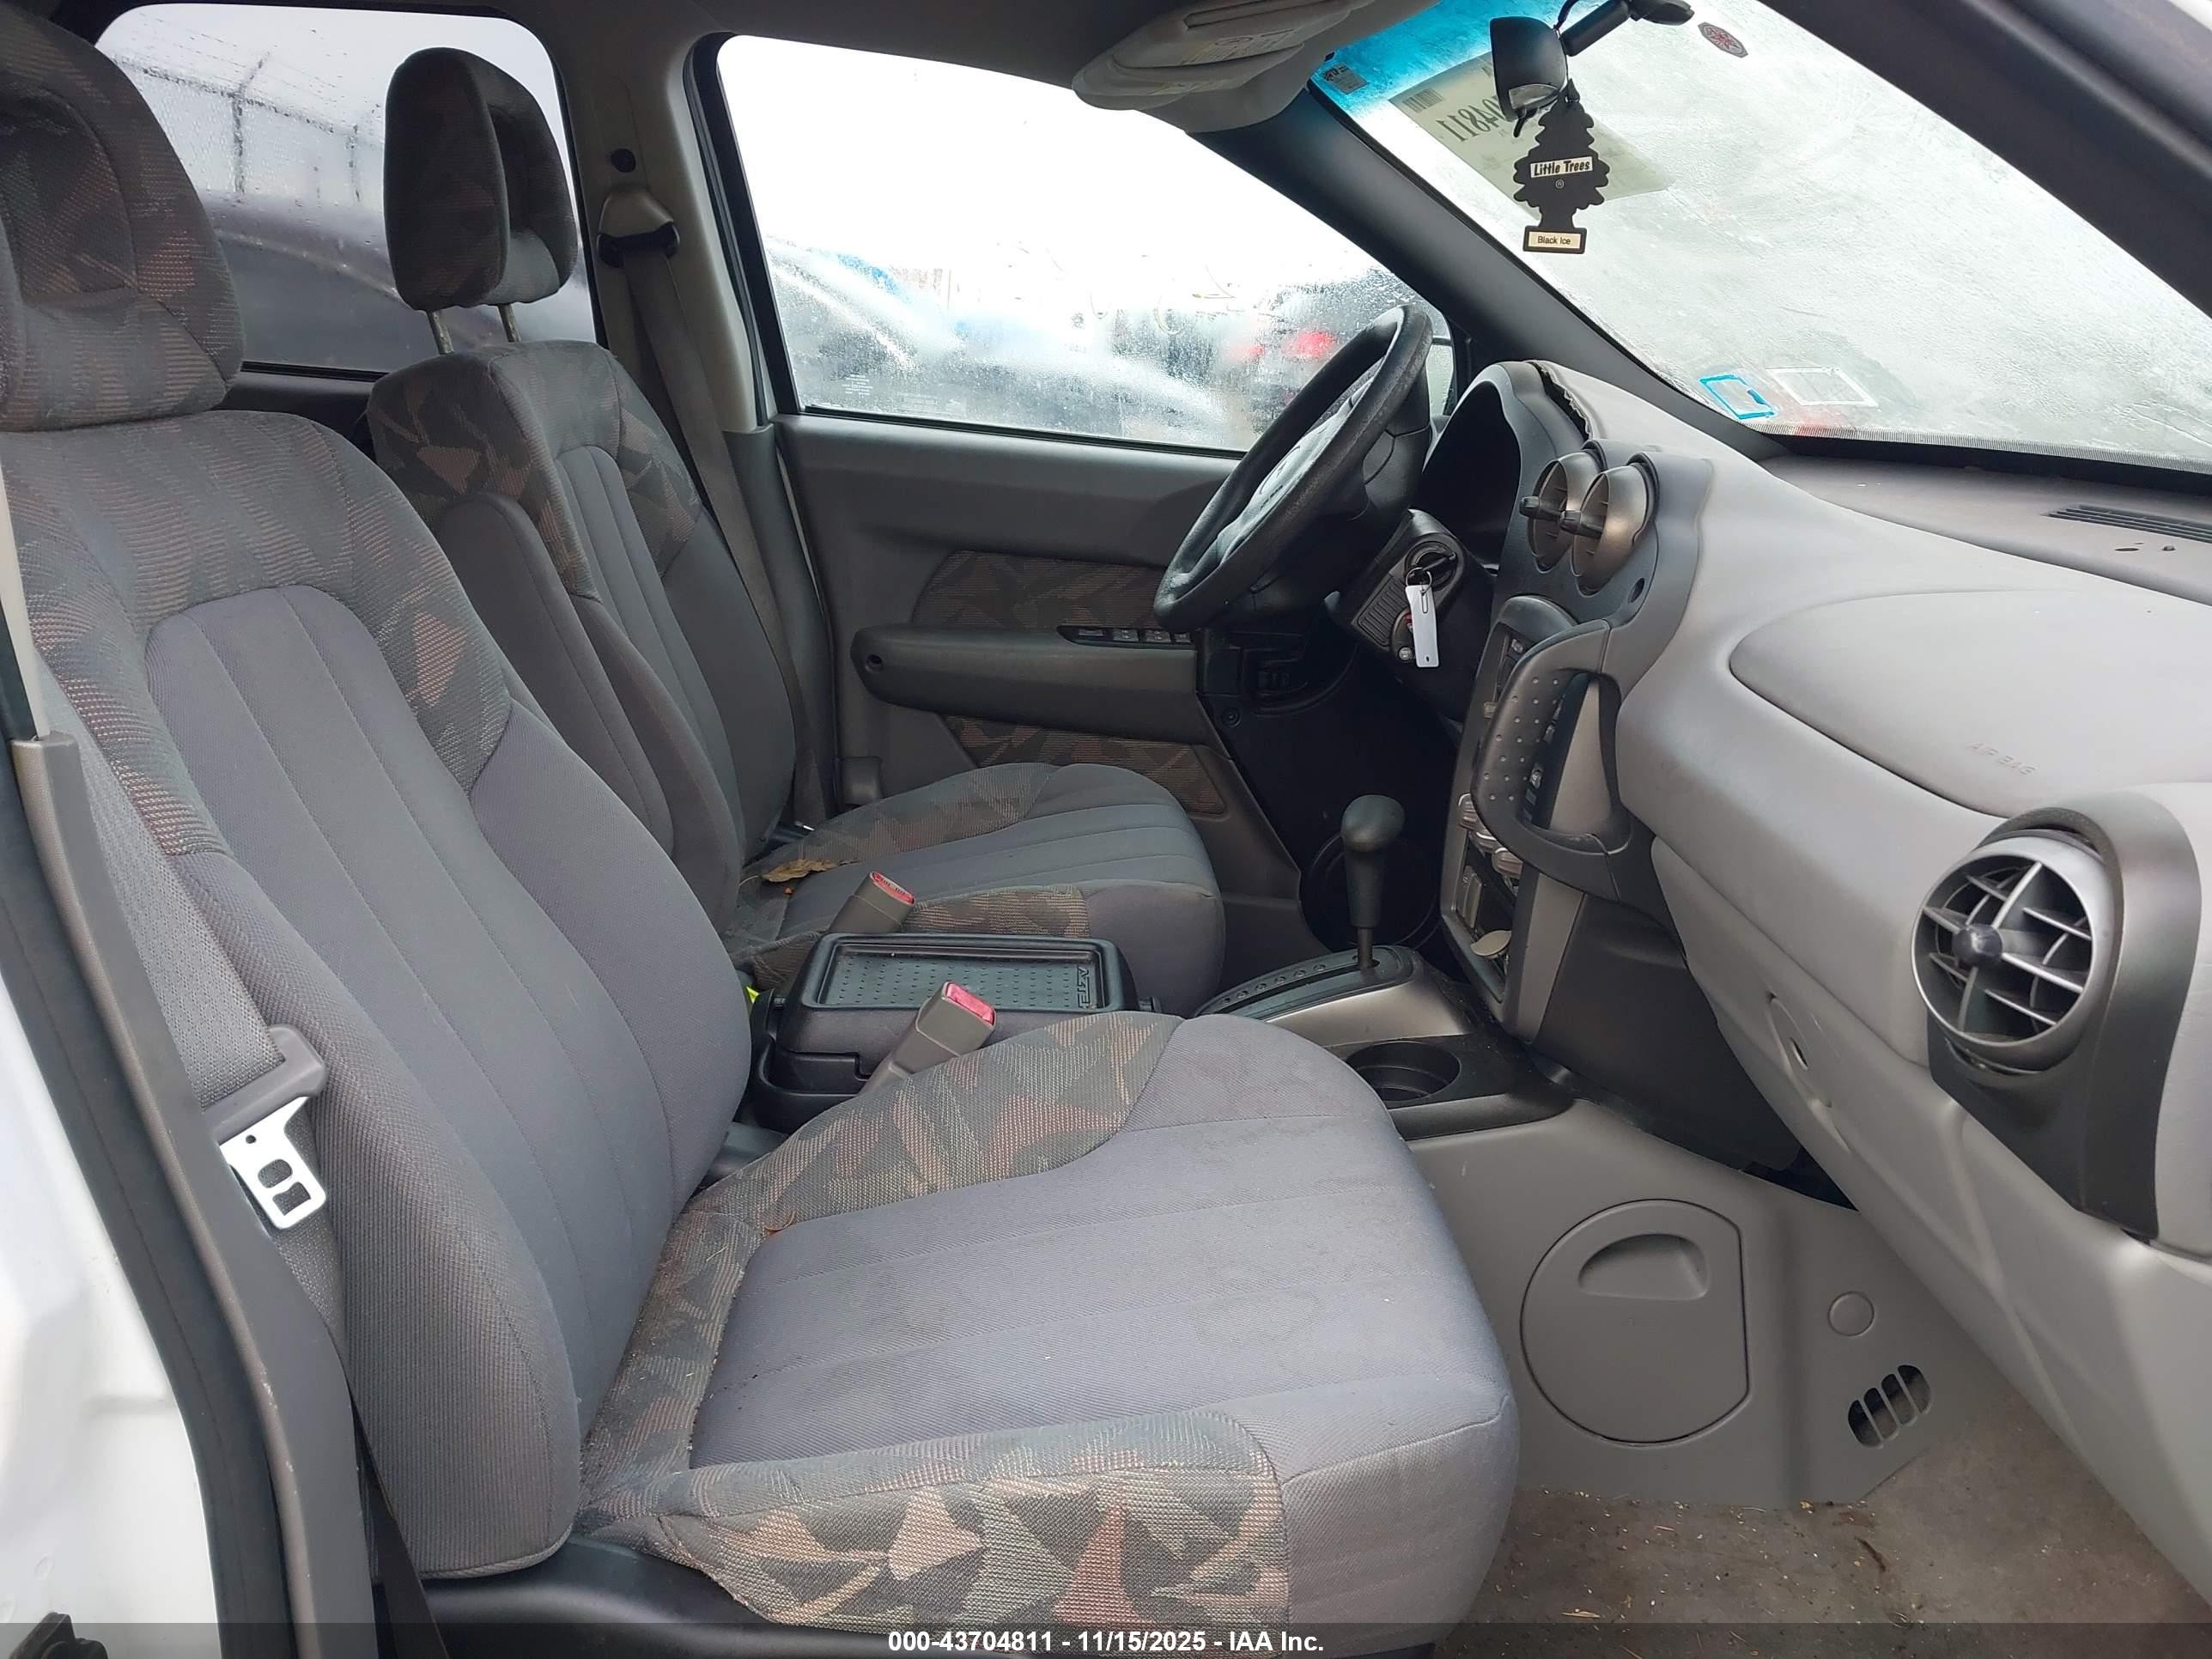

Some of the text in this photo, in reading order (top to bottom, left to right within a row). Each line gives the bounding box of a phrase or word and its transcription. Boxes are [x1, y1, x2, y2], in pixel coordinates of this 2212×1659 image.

[1534, 160, 1590, 176] Little Trees
[1537, 235, 1571, 245] Black Ice
